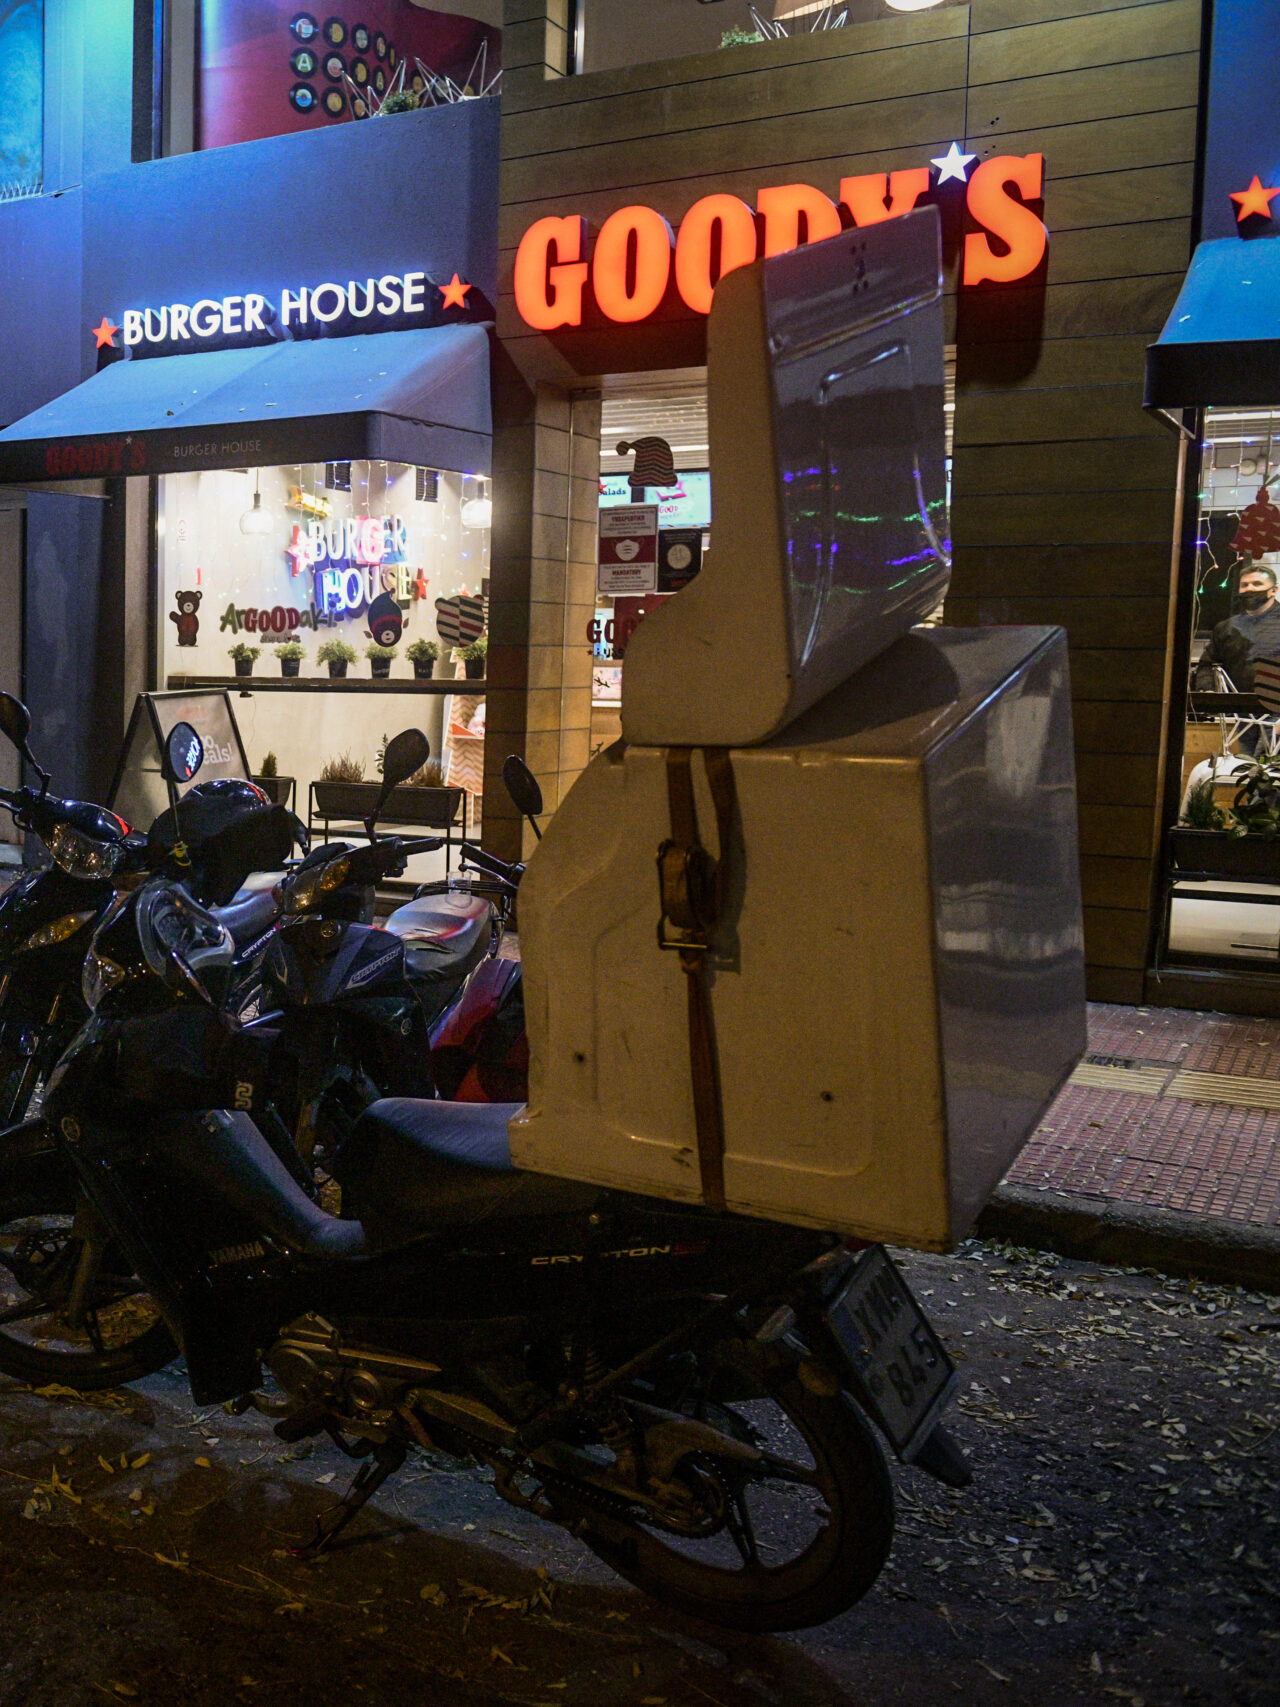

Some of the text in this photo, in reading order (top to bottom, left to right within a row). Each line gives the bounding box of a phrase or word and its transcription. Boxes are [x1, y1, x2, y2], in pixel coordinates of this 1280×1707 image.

[123, 271, 425, 345] BURGER HOUSE
[174, 439, 262, 457] BURGER HOUSE
[308, 514, 408, 563] BURGER
[531, 1245, 671, 1265] CRYTON
